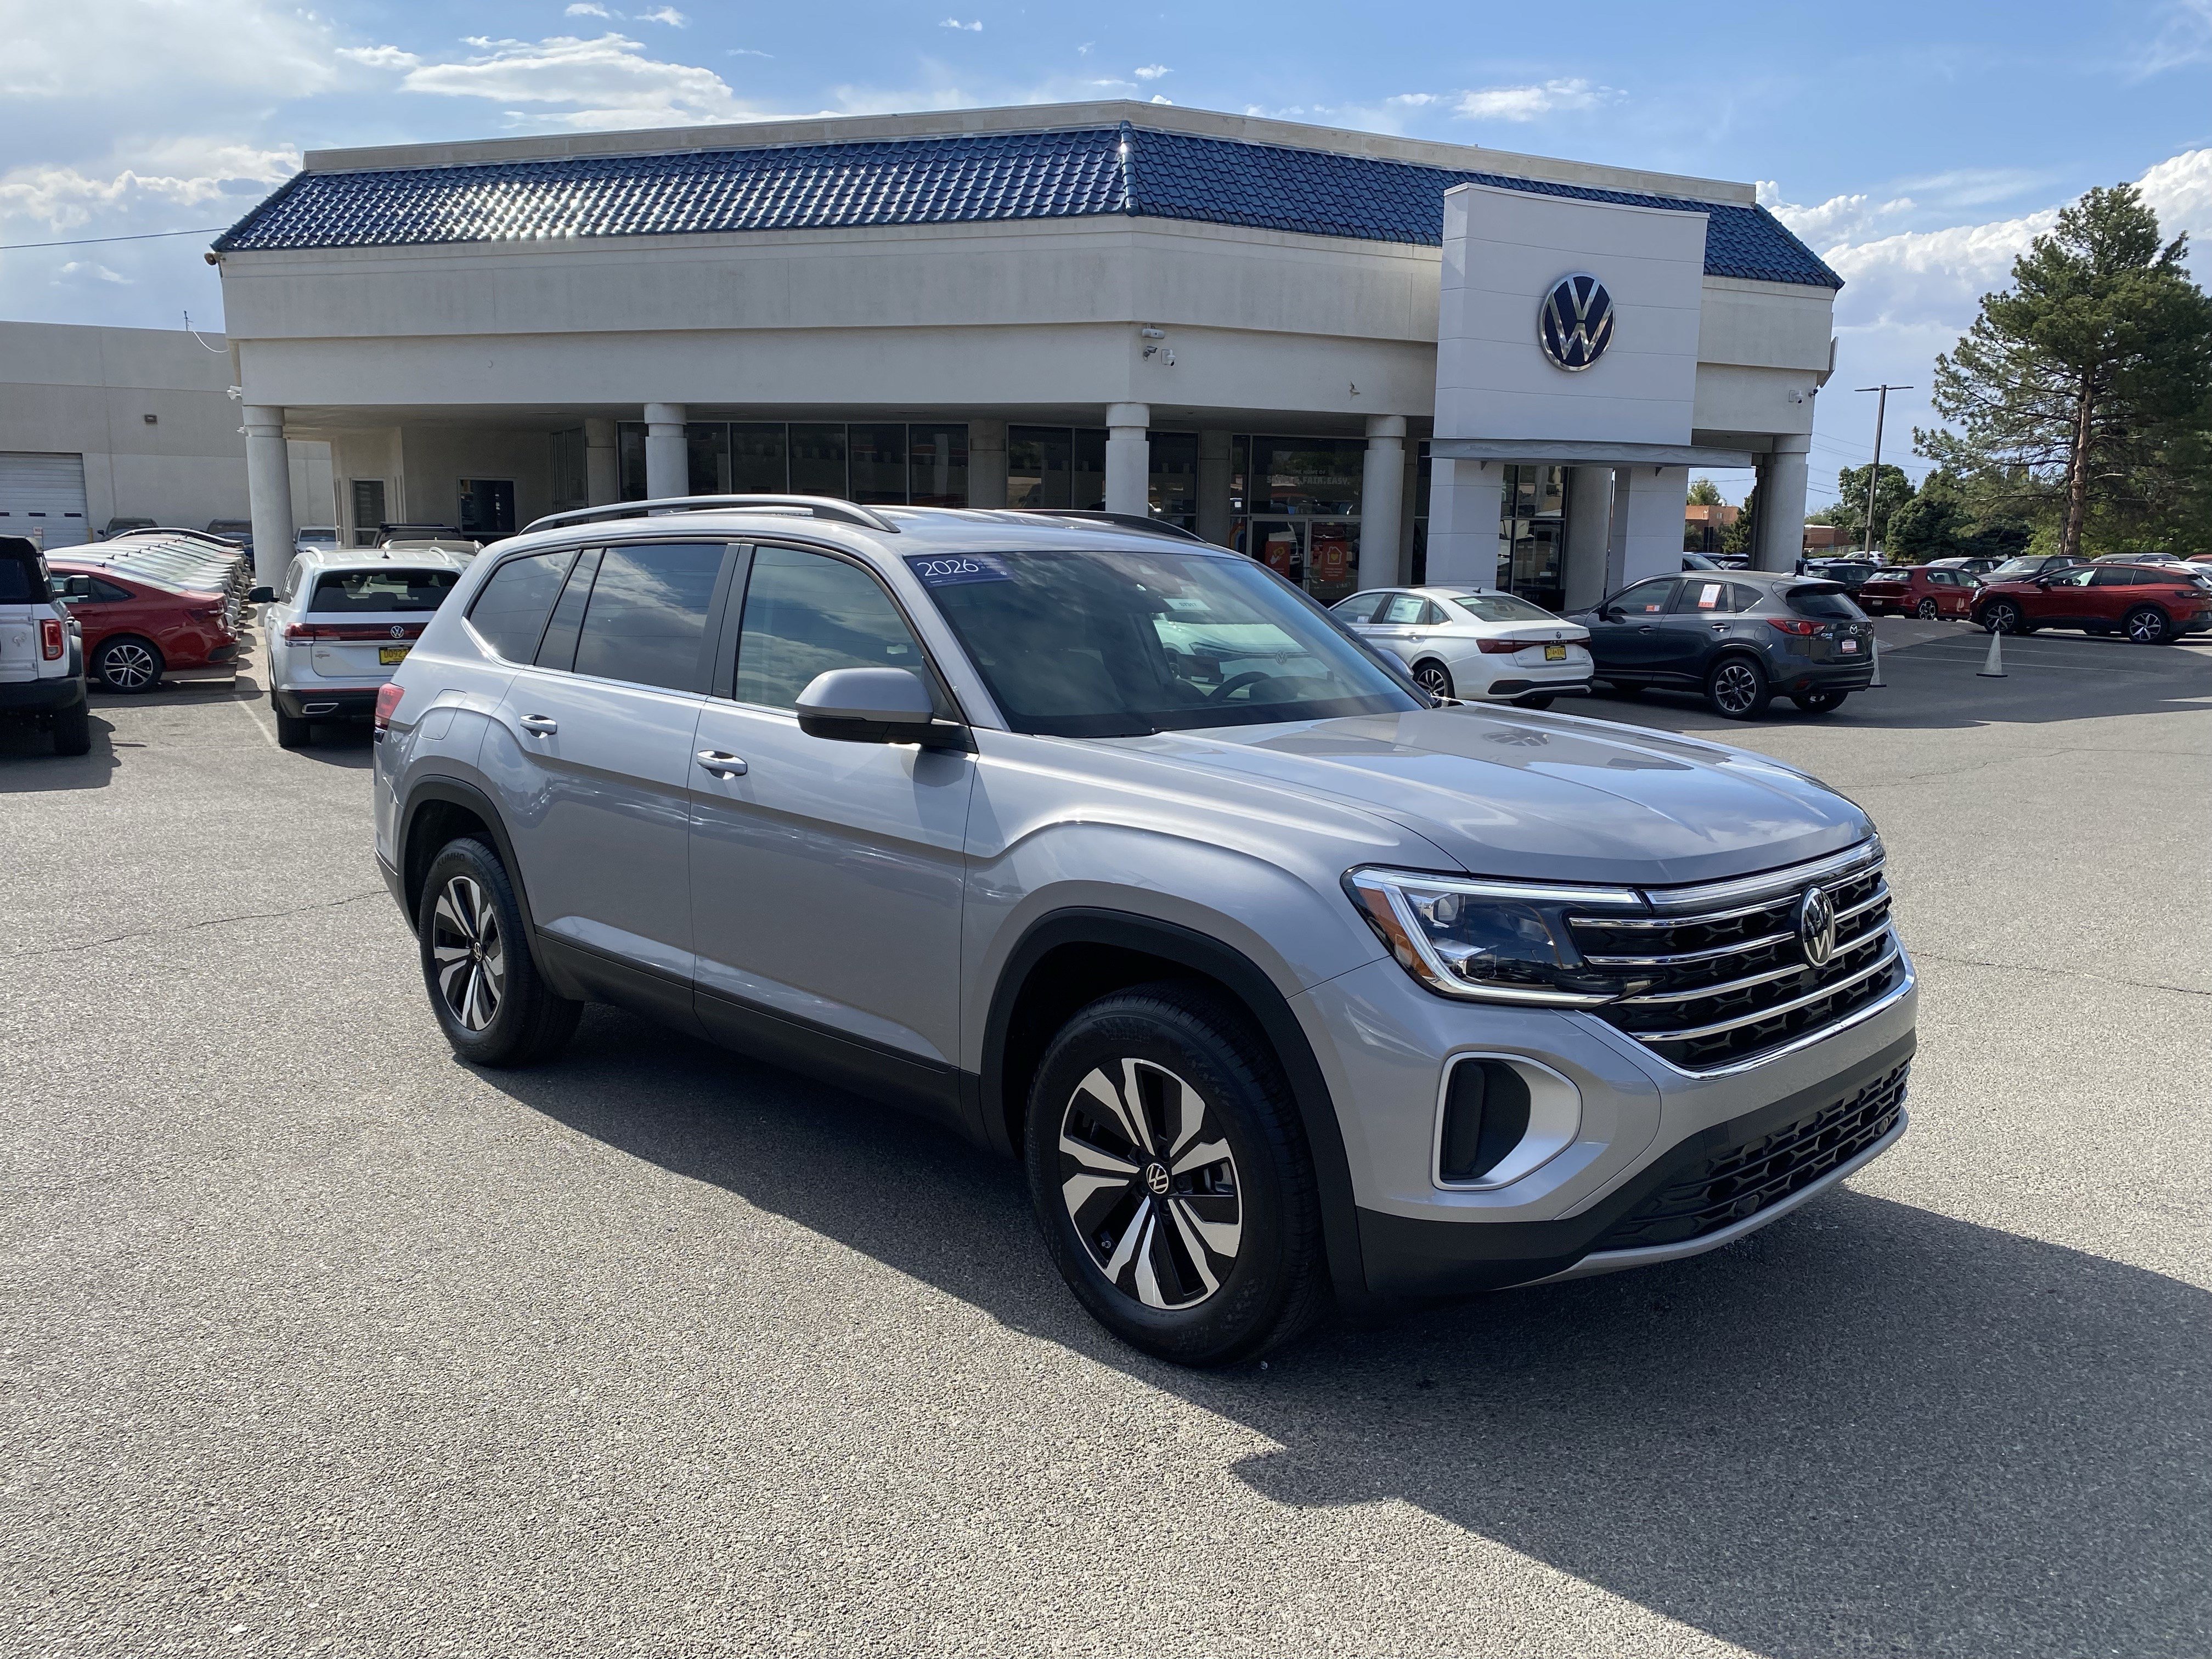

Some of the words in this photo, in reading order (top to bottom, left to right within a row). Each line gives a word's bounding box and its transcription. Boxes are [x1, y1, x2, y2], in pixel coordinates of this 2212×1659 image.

[1538, 271, 1615, 372] VW
[917, 559, 979, 577] 2026
[390, 625, 404, 639] VW
[1146, 1163, 1169, 1194] VW
